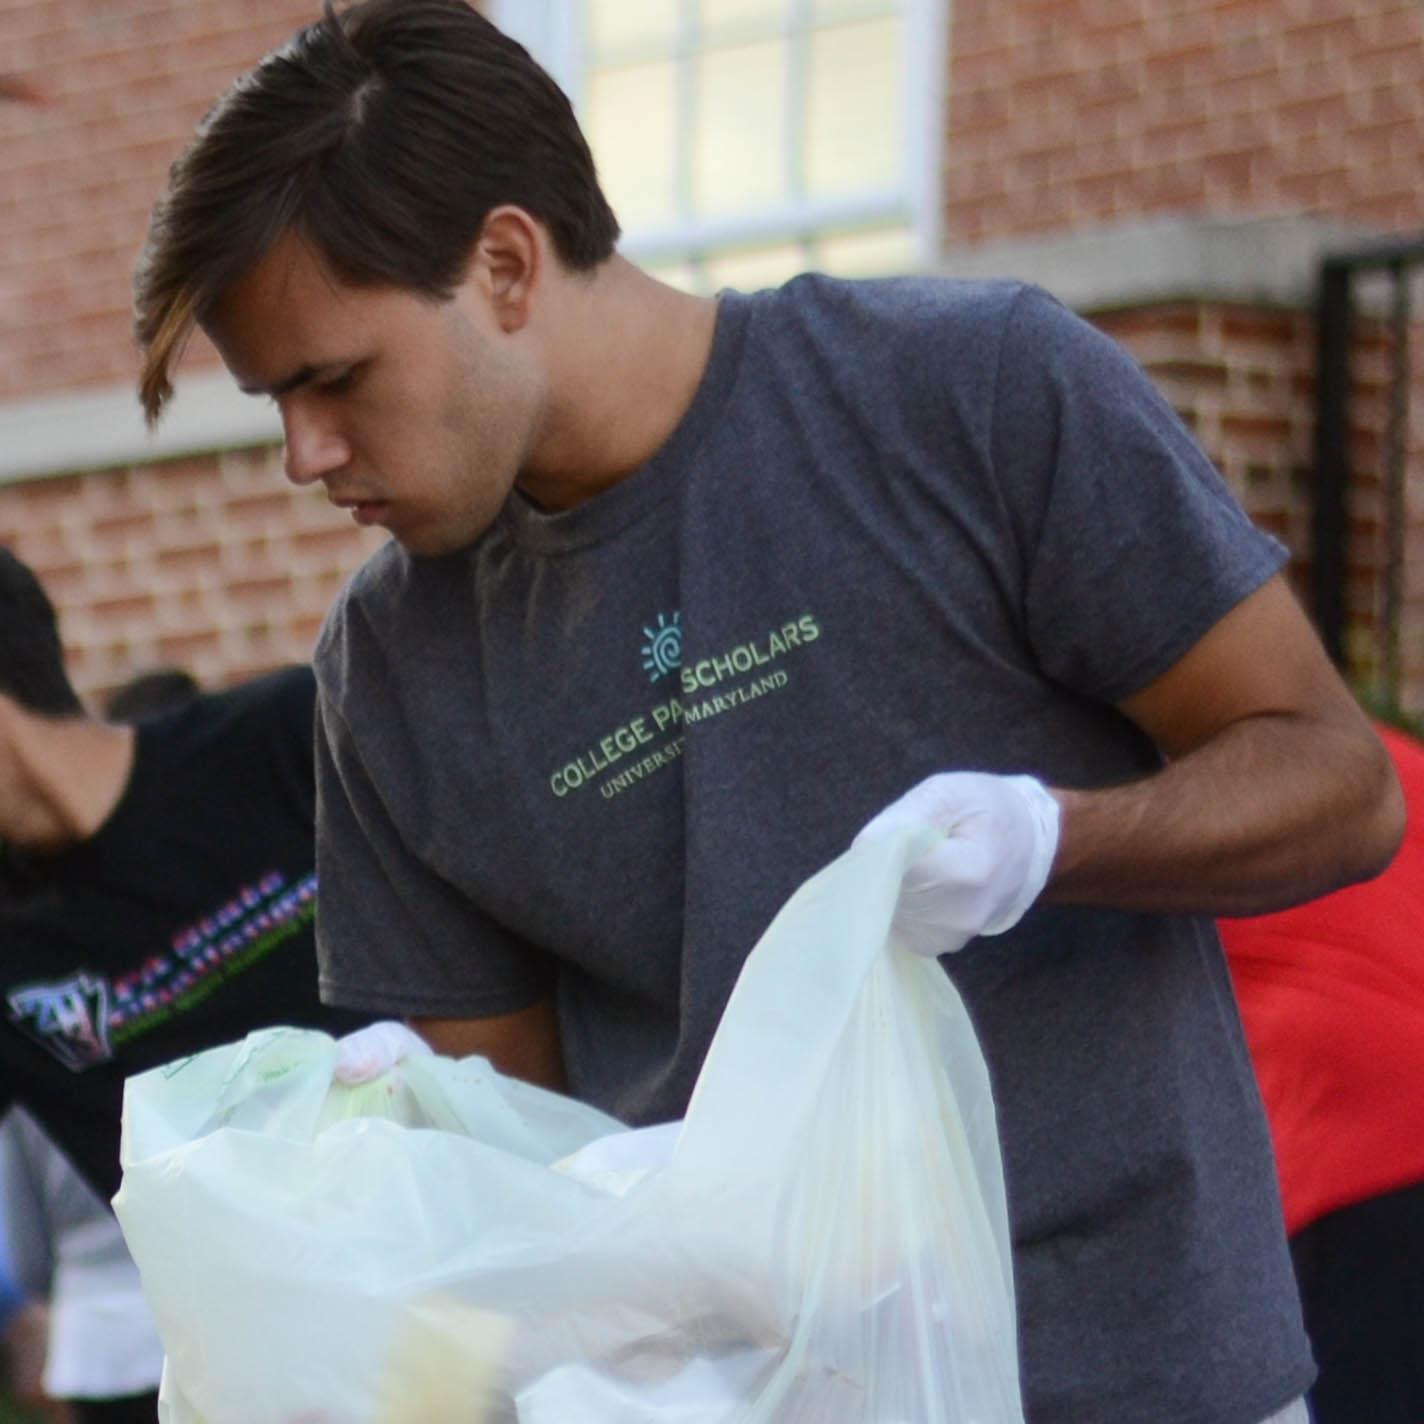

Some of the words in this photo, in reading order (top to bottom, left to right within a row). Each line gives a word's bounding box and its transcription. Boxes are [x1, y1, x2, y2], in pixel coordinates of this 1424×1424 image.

[551, 717, 654, 798] COLLEGE
[652, 699, 685, 732] PA
[679, 613, 821, 694] SCHOLARS
[600, 736, 687, 800] UNIVERSI
[682, 669, 789, 725] MARYLAND
